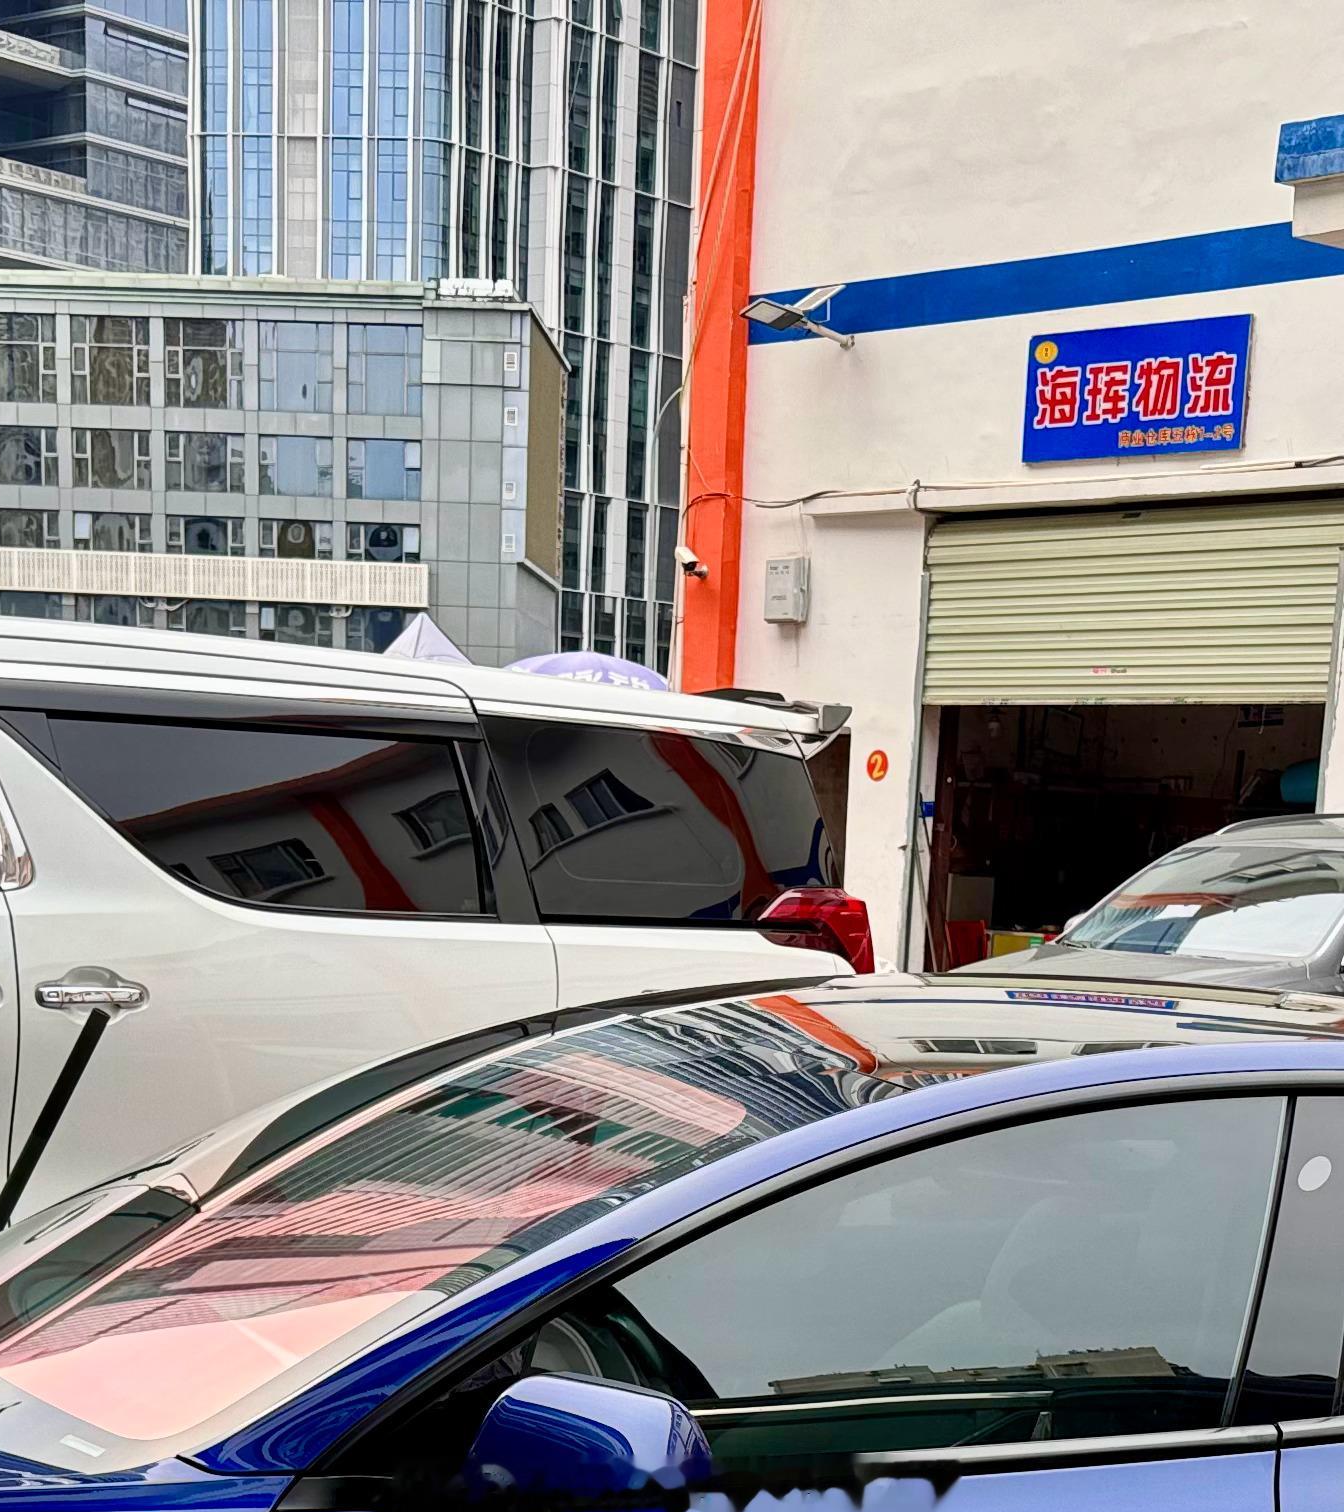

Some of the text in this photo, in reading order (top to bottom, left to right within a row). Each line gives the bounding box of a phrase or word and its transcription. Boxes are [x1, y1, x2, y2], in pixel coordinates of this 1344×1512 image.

[1033, 350, 1237, 428] 海珲物流
[870, 753, 885, 779] 2
